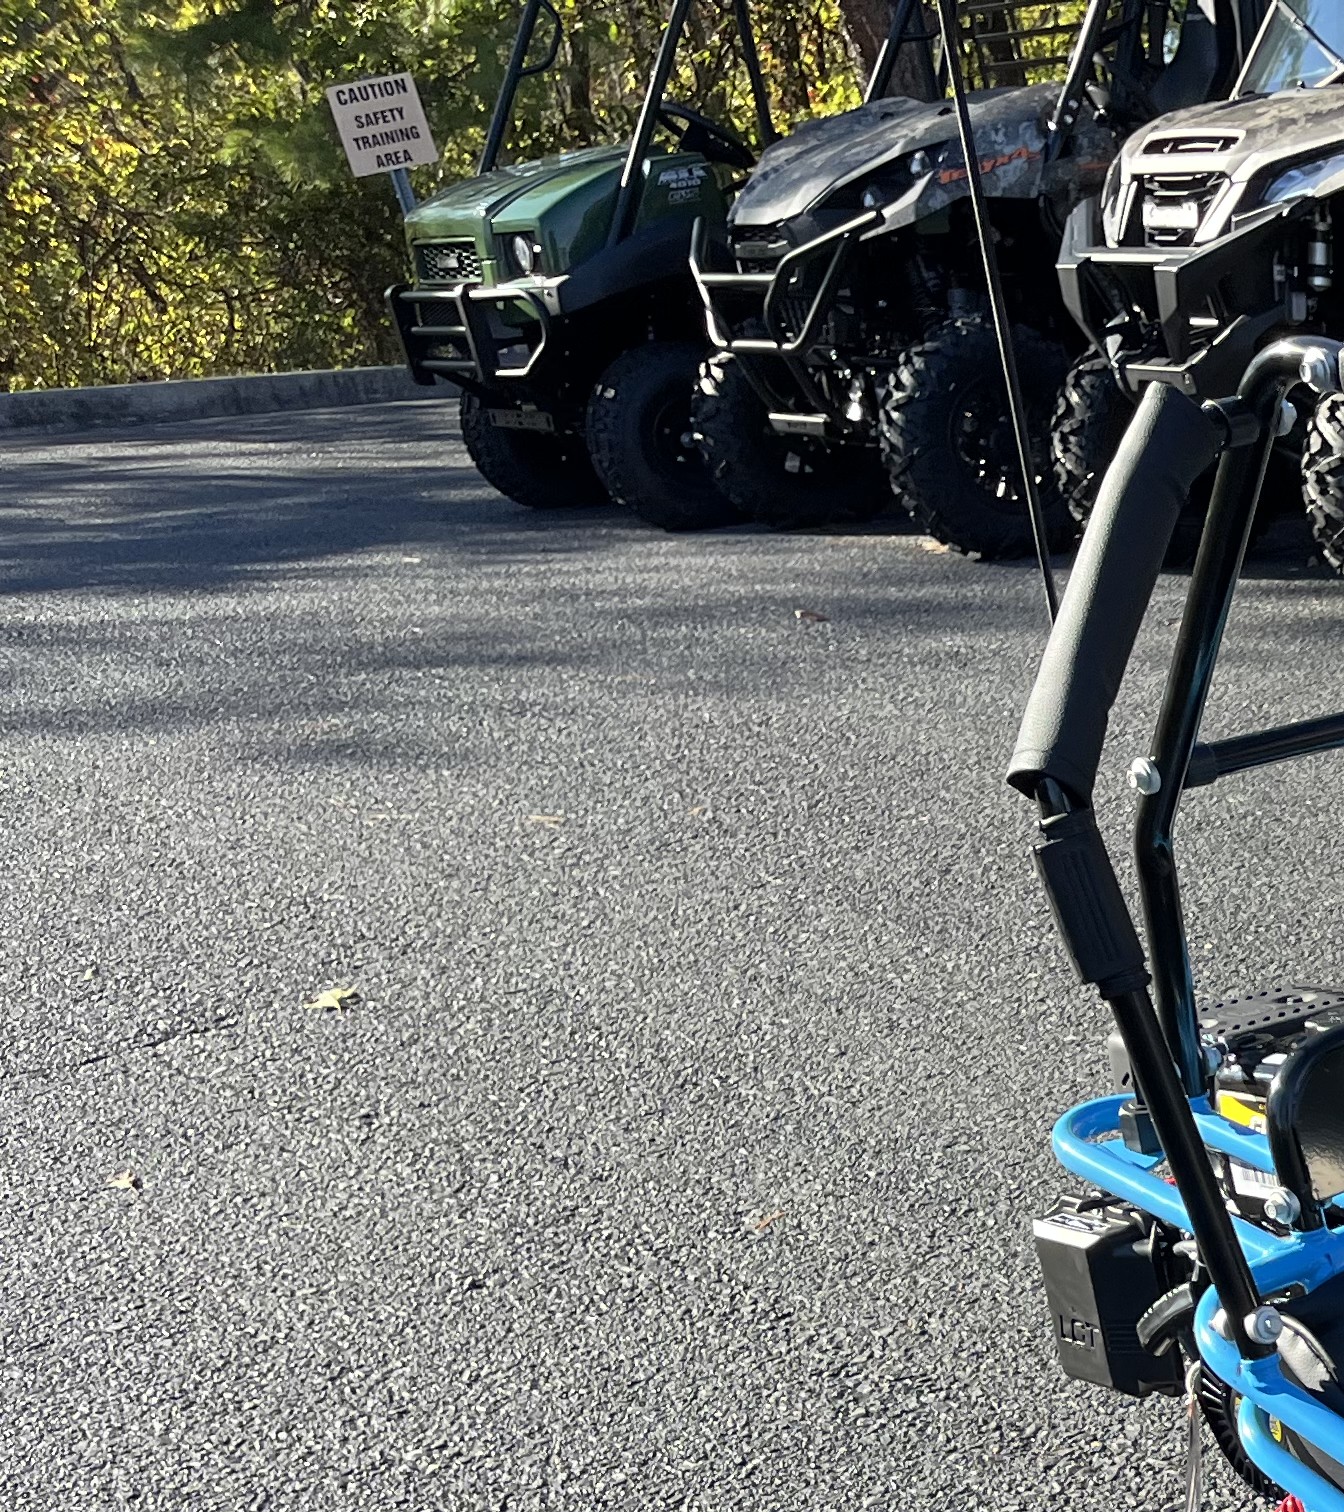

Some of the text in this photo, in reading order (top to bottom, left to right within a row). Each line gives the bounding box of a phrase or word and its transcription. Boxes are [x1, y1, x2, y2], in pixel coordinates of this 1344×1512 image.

[336, 78, 408, 106] CAUTION
[354, 107, 406, 129] SAFETY
[353, 125, 420, 151] TRAINING
[376, 149, 413, 169] AREA
[1060, 1315, 1100, 1347] LCT
